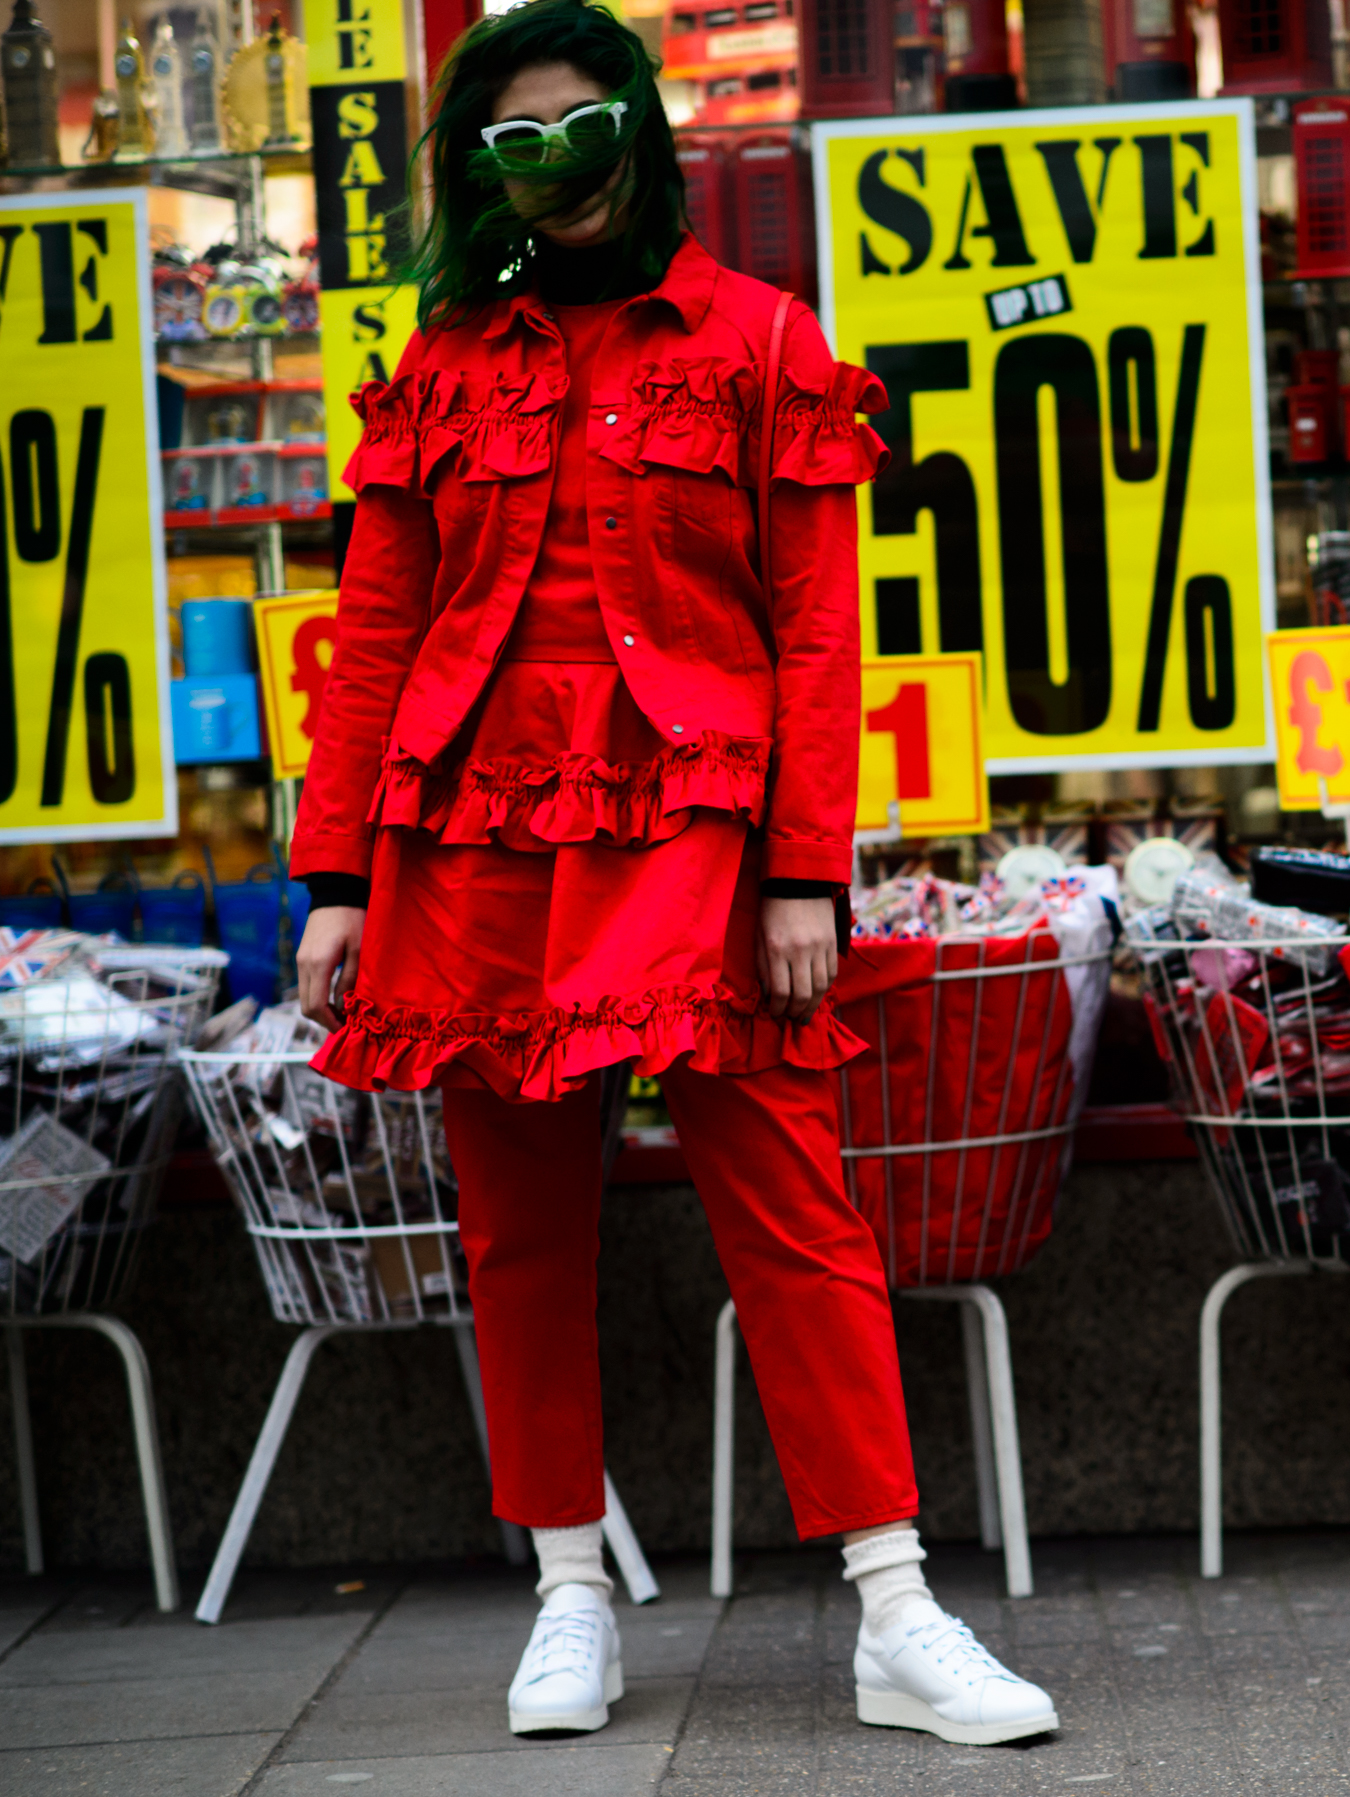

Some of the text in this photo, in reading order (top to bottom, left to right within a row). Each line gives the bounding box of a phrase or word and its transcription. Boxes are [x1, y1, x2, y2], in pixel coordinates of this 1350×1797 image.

[338, 92, 388, 281] SALE
[856, 131, 1216, 278] SAVE
[0, 217, 113, 346] E
[990, 287, 1028, 326] UP
[863, 322, 1237, 737] 50%
[866, 682, 931, 800] 1
